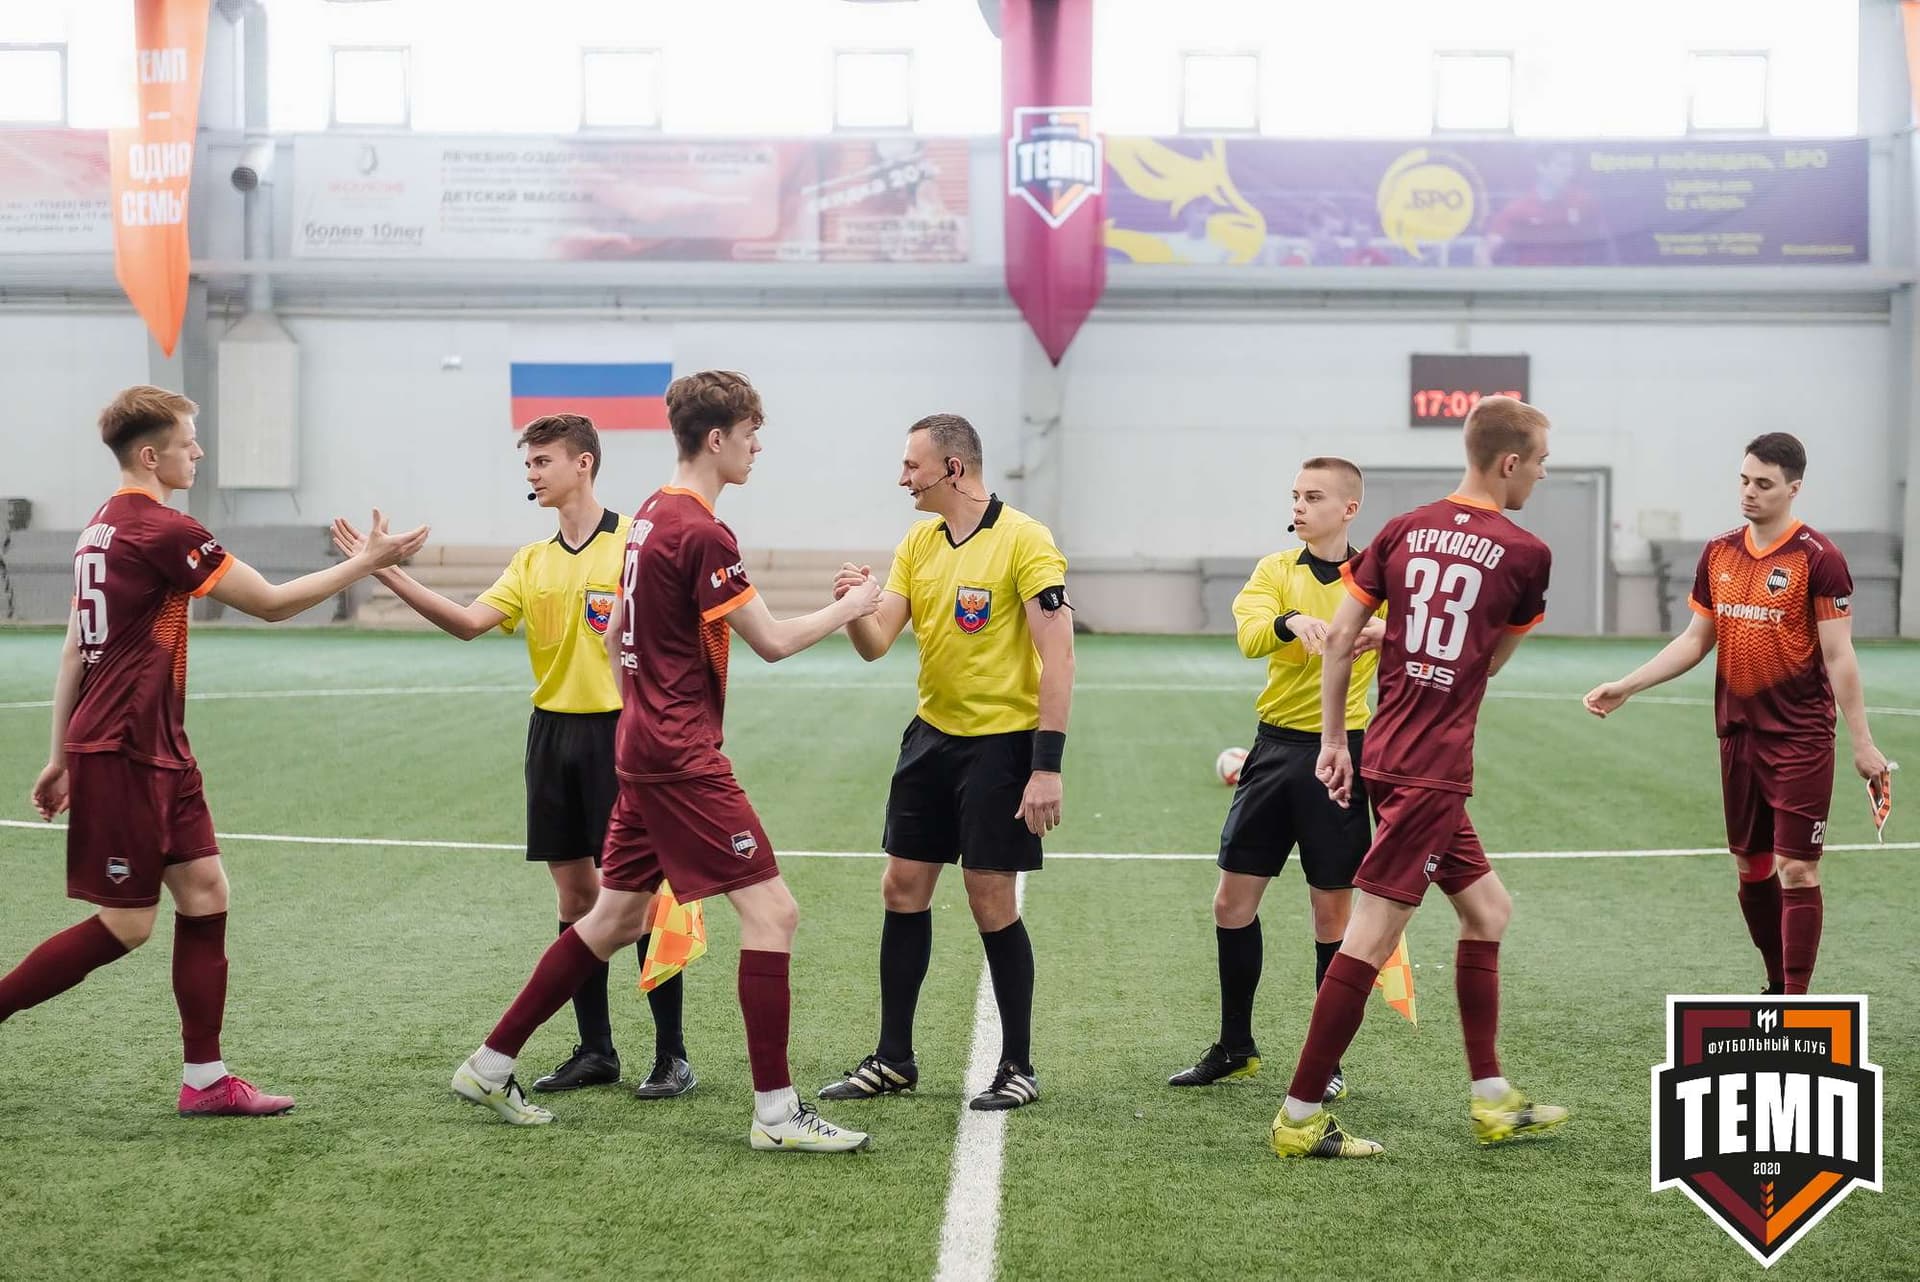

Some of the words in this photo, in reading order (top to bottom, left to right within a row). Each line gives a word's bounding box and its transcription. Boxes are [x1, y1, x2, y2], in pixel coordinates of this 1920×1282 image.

[1017, 140, 1094, 182] ТЕМП
[121, 187, 188, 227] СЕМЬ
[1406, 528, 1506, 571] ЧЕРКАСОВ
[74, 552, 110, 646] 5
[1404, 557, 1483, 662] 33
